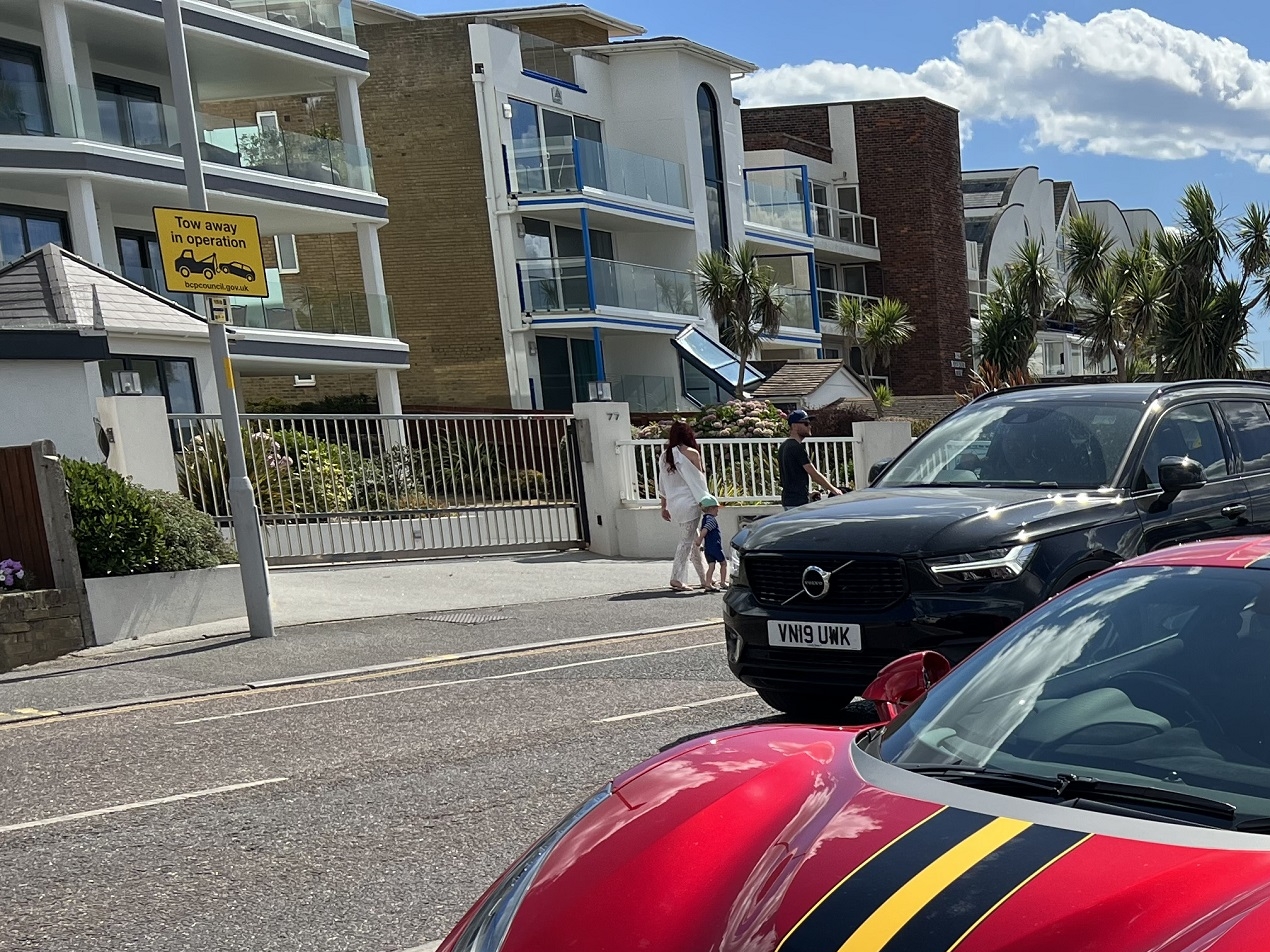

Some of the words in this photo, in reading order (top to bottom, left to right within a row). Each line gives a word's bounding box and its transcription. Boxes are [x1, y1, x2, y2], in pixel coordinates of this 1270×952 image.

[174, 216, 201, 229] Tow
[205, 221, 237, 235] away
[171, 231, 183, 243] in
[186, 235, 247, 248] operation
[184, 281, 249, 292] bcpcouncil.gov.uk
[606, 411, 620, 421] 77
[778, 623, 814, 644] VN19
[818, 625, 851, 646] UWK
